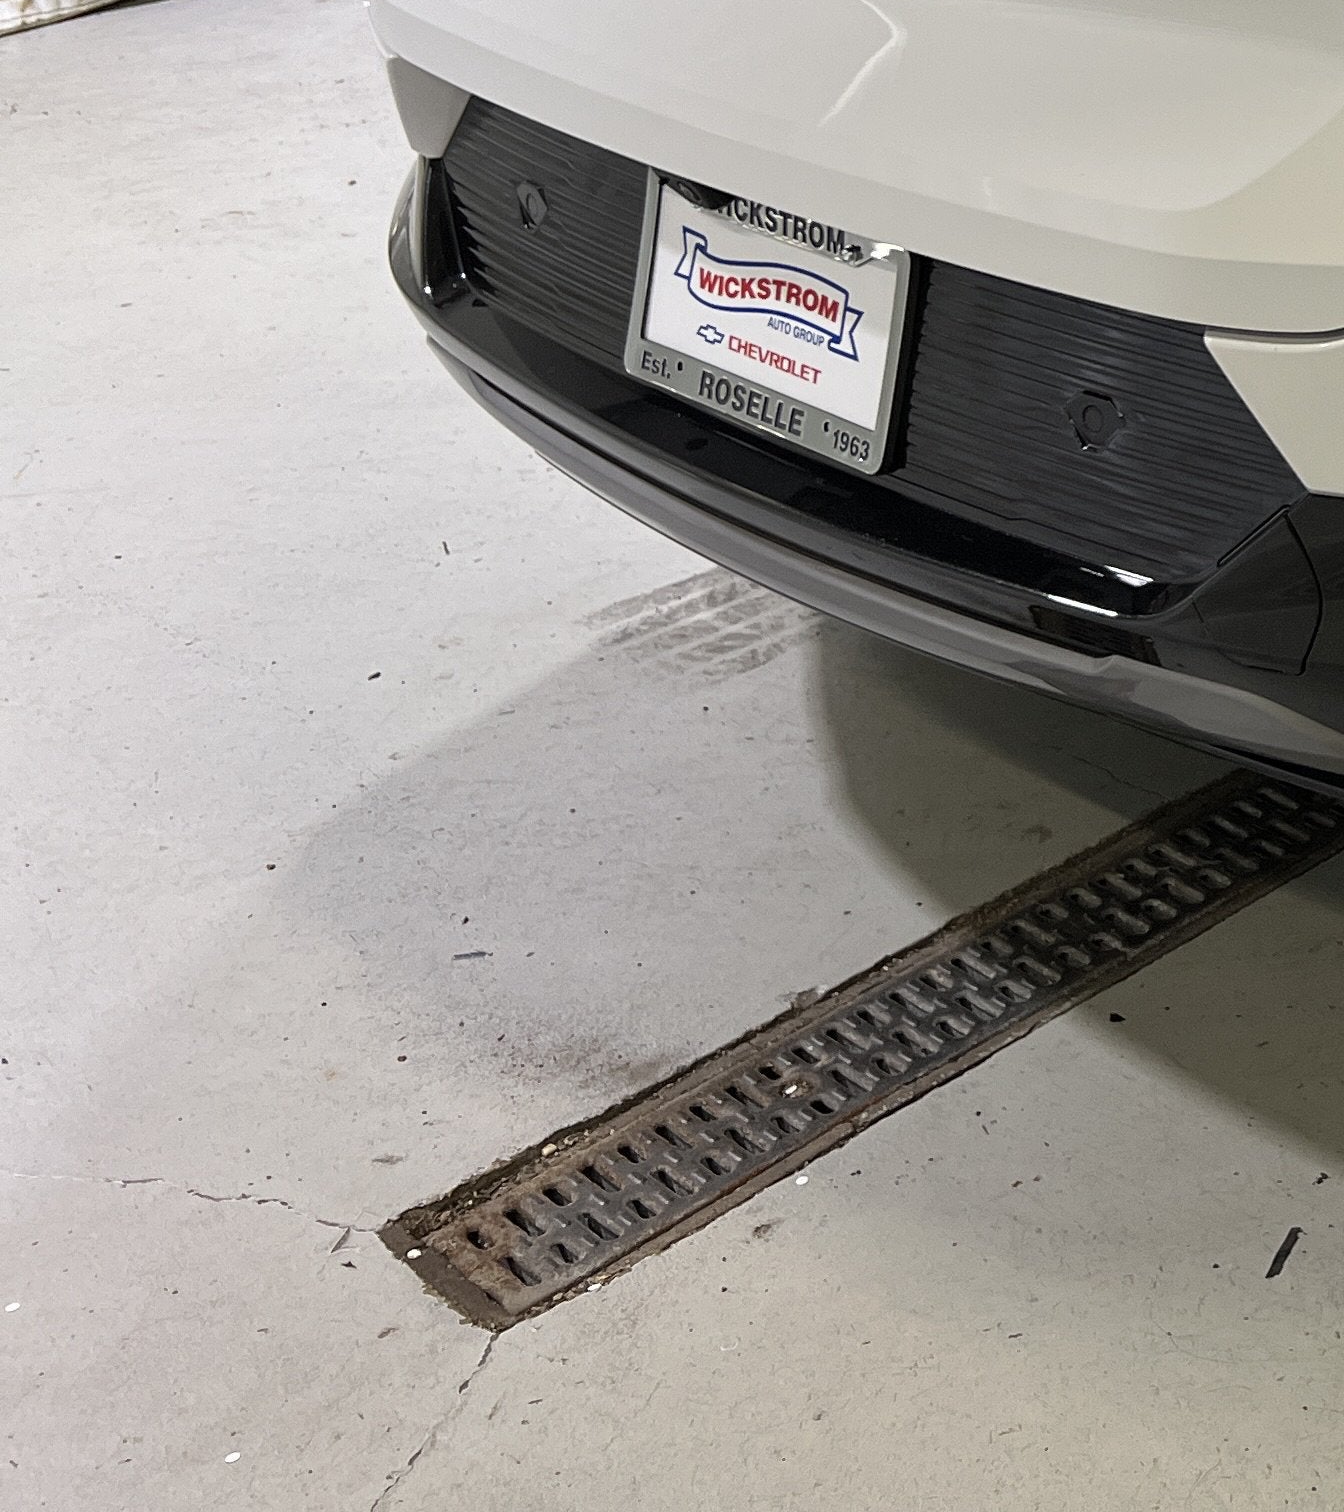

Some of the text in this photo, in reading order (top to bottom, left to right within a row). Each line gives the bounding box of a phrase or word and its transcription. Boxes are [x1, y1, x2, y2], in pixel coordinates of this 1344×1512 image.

[718, 199, 846, 255] ICKSTROM
[699, 267, 841, 323] WICKSTROM
[728, 335, 822, 385] CHEVROLET
[767, 317, 825, 348] AUTO GROUP
[641, 350, 871, 462] Est. ROSELLE 1963
